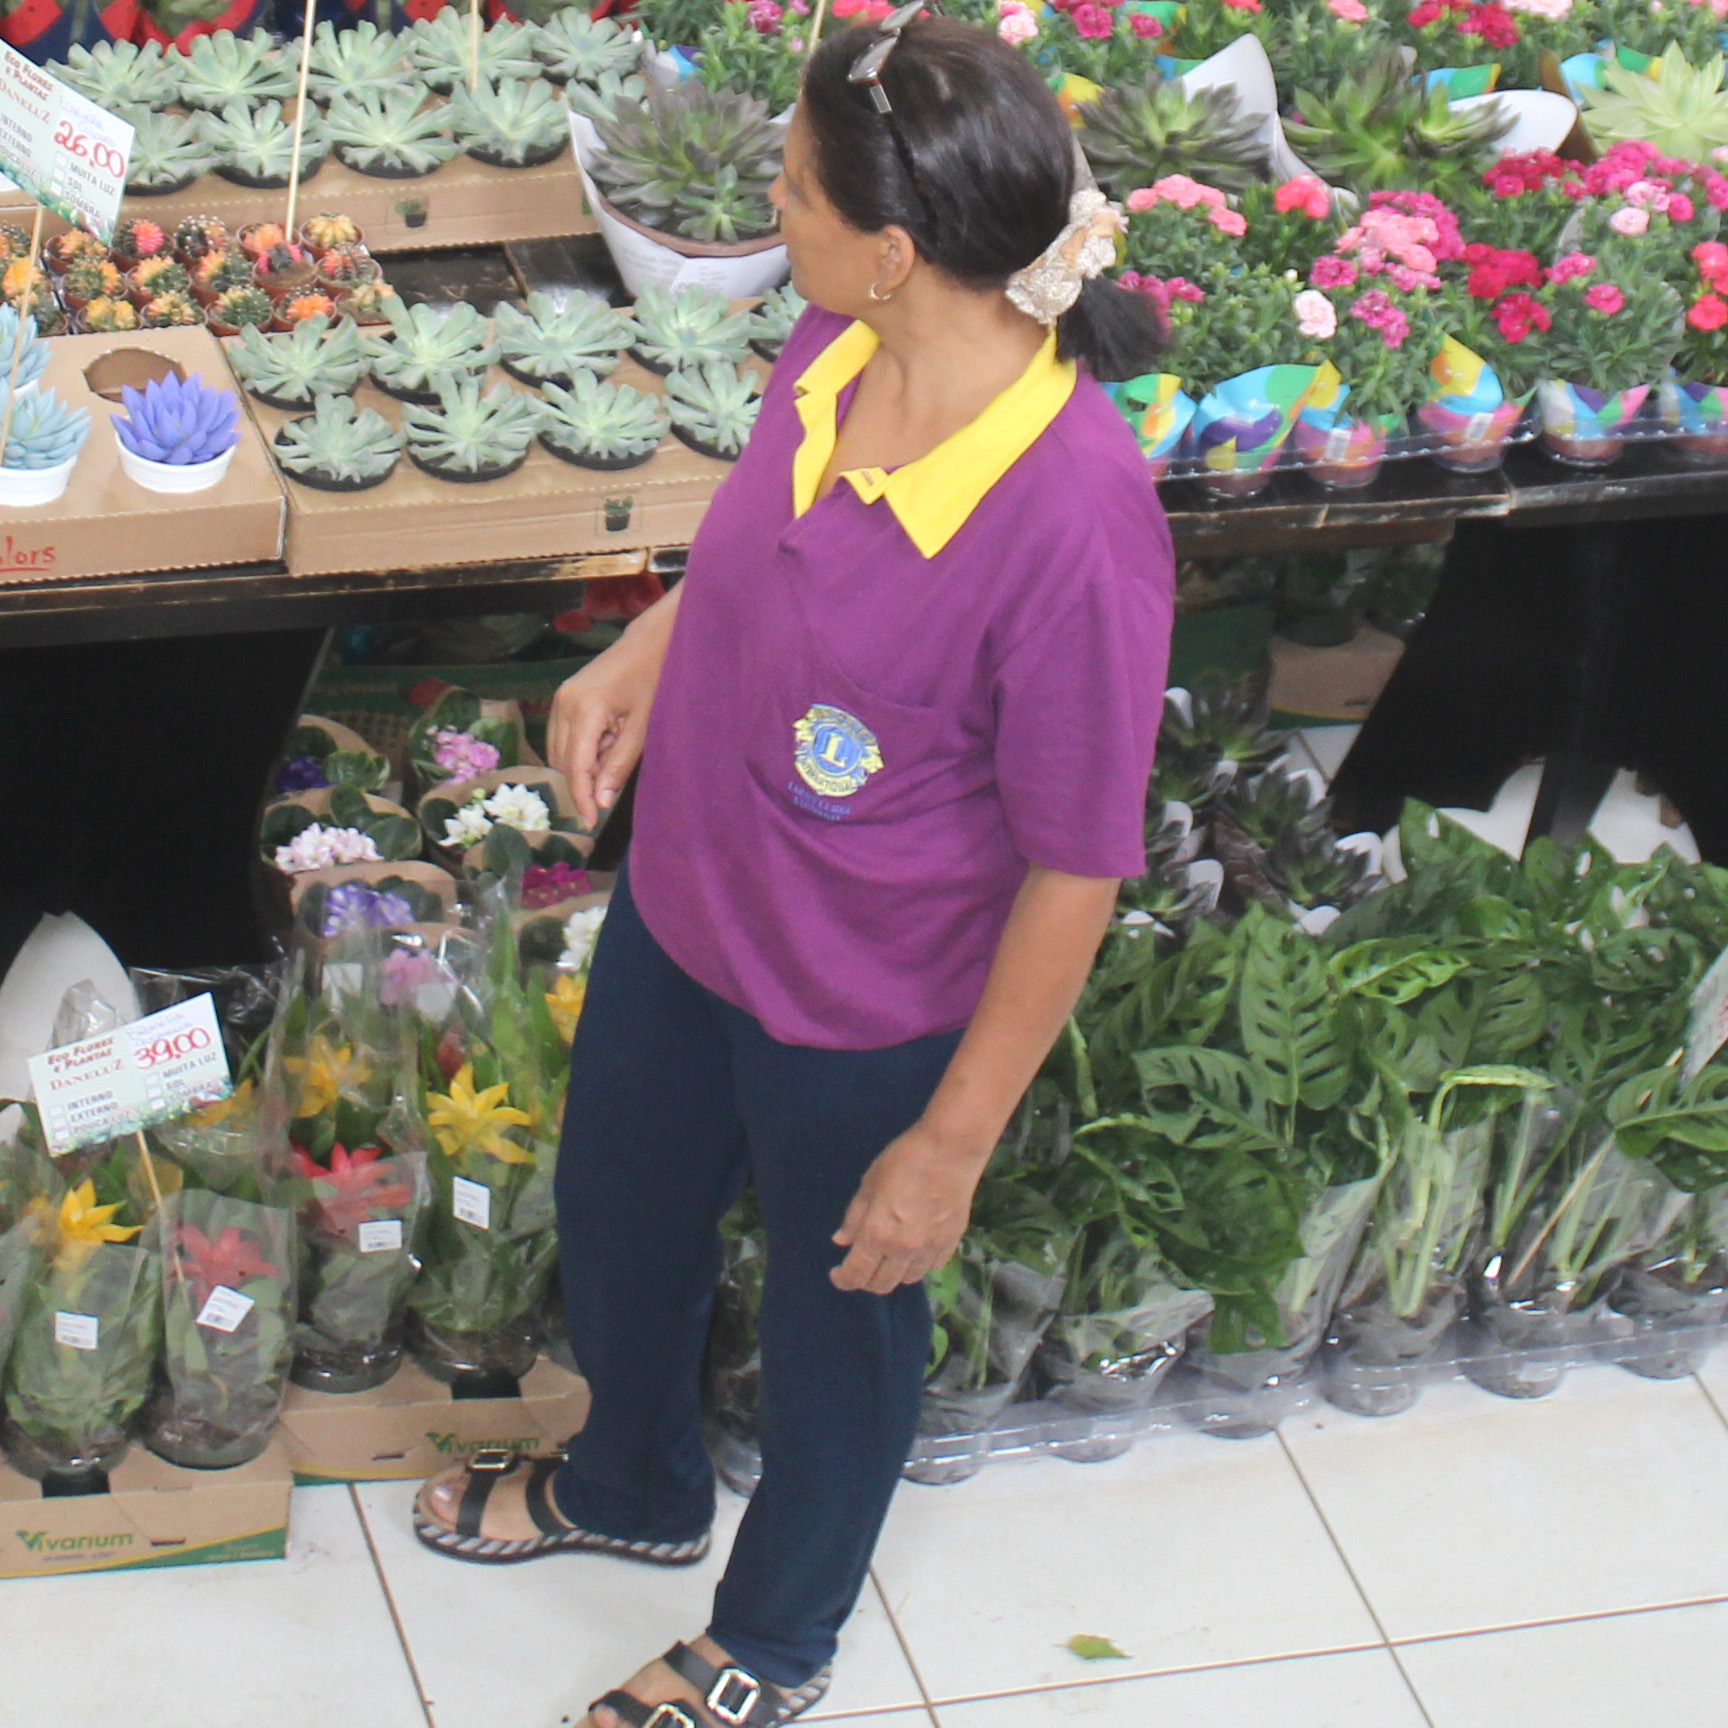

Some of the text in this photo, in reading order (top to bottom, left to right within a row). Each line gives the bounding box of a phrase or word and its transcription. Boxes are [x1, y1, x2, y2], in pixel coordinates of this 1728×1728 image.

[4, 50, 55, 91] ECO FLORES
[12, 69, 49, 101] PLANTAS
[0, 113, 33, 143] INTERNO
[67, 176, 83, 193] SOL
[70, 161, 117, 197] MUITA LUZ
[64, 189, 101, 218] SOMBRA
[820, 732, 848, 768] L
[47, 1035, 115, 1066] ECO FLORES
[64, 1048, 113, 1071] PLANTAS
[49, 1058, 124, 1091] DANELUZ
[162, 1052, 218, 1078] MUITA LUZ
[166, 1079, 185, 1091] SOL
[168, 1081, 213, 1104] SOMBRA
[67, 1090, 114, 1111] INTERNO
[70, 1102, 119, 1122] EXTERNO
[73, 1116, 109, 1134] POUCA
[16, 1529, 135, 1552] Vivarium
